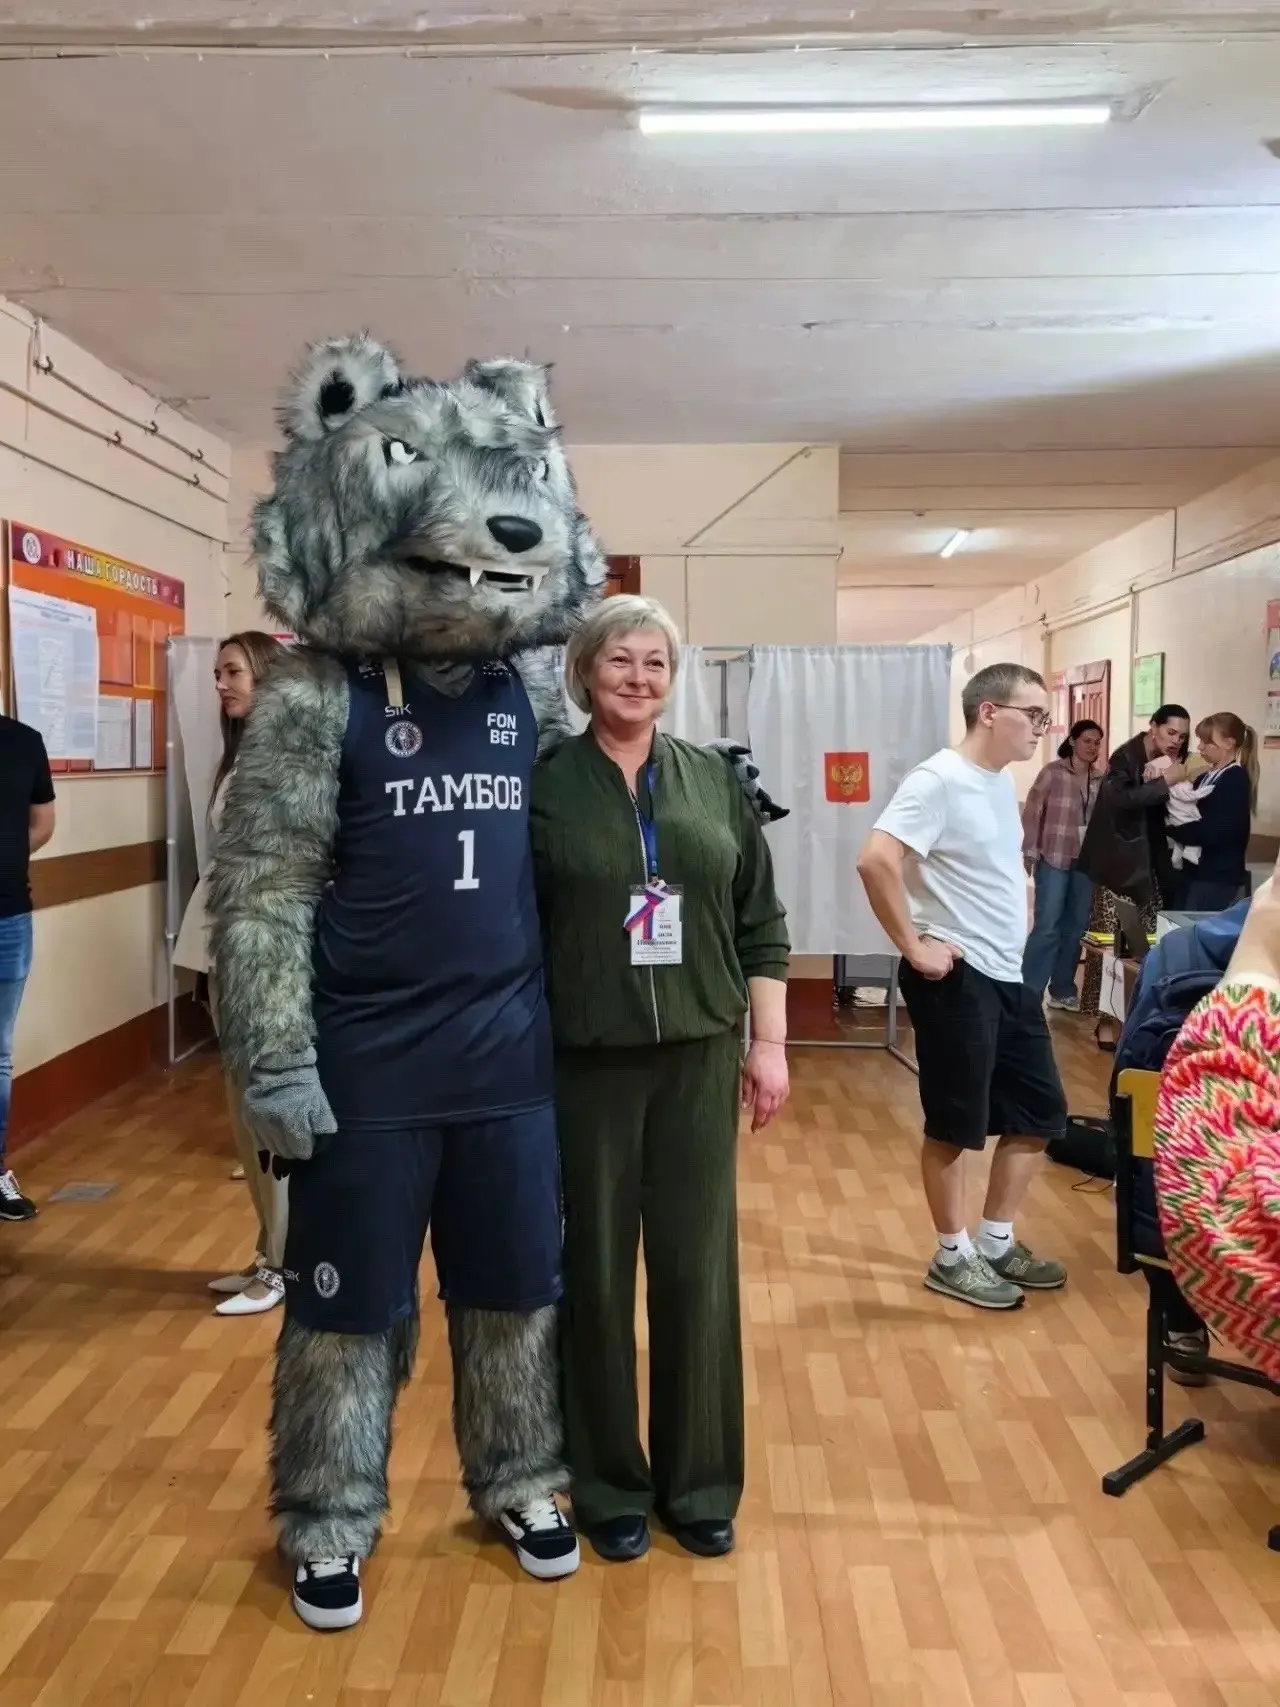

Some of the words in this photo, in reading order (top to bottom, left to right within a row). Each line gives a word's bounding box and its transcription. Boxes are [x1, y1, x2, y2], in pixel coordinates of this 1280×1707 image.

[67, 549, 102, 579] НАША
[104, 561, 159, 596] ГОРДОСТЬ
[487, 712, 517, 730] FON
[490, 729, 518, 746] BET
[385, 772, 523, 817] ТАМБОВ
[454, 829, 480, 890] 1
